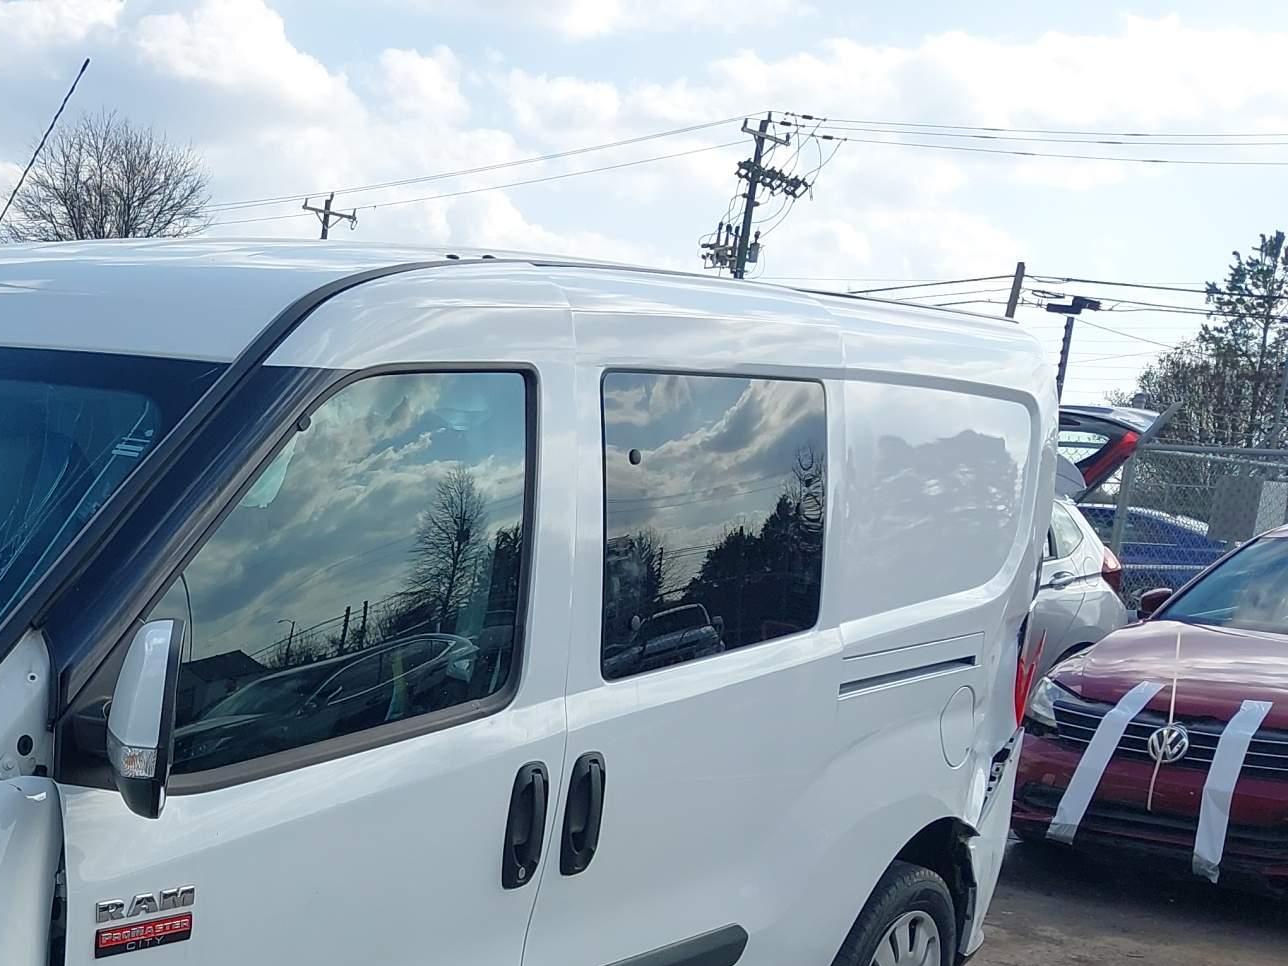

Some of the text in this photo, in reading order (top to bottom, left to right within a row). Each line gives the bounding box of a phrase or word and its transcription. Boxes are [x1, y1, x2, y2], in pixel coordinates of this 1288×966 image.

[95, 885, 195, 923] RAM
[101, 918, 190, 944] PROMASTER
[126, 935, 165, 951] CITY
